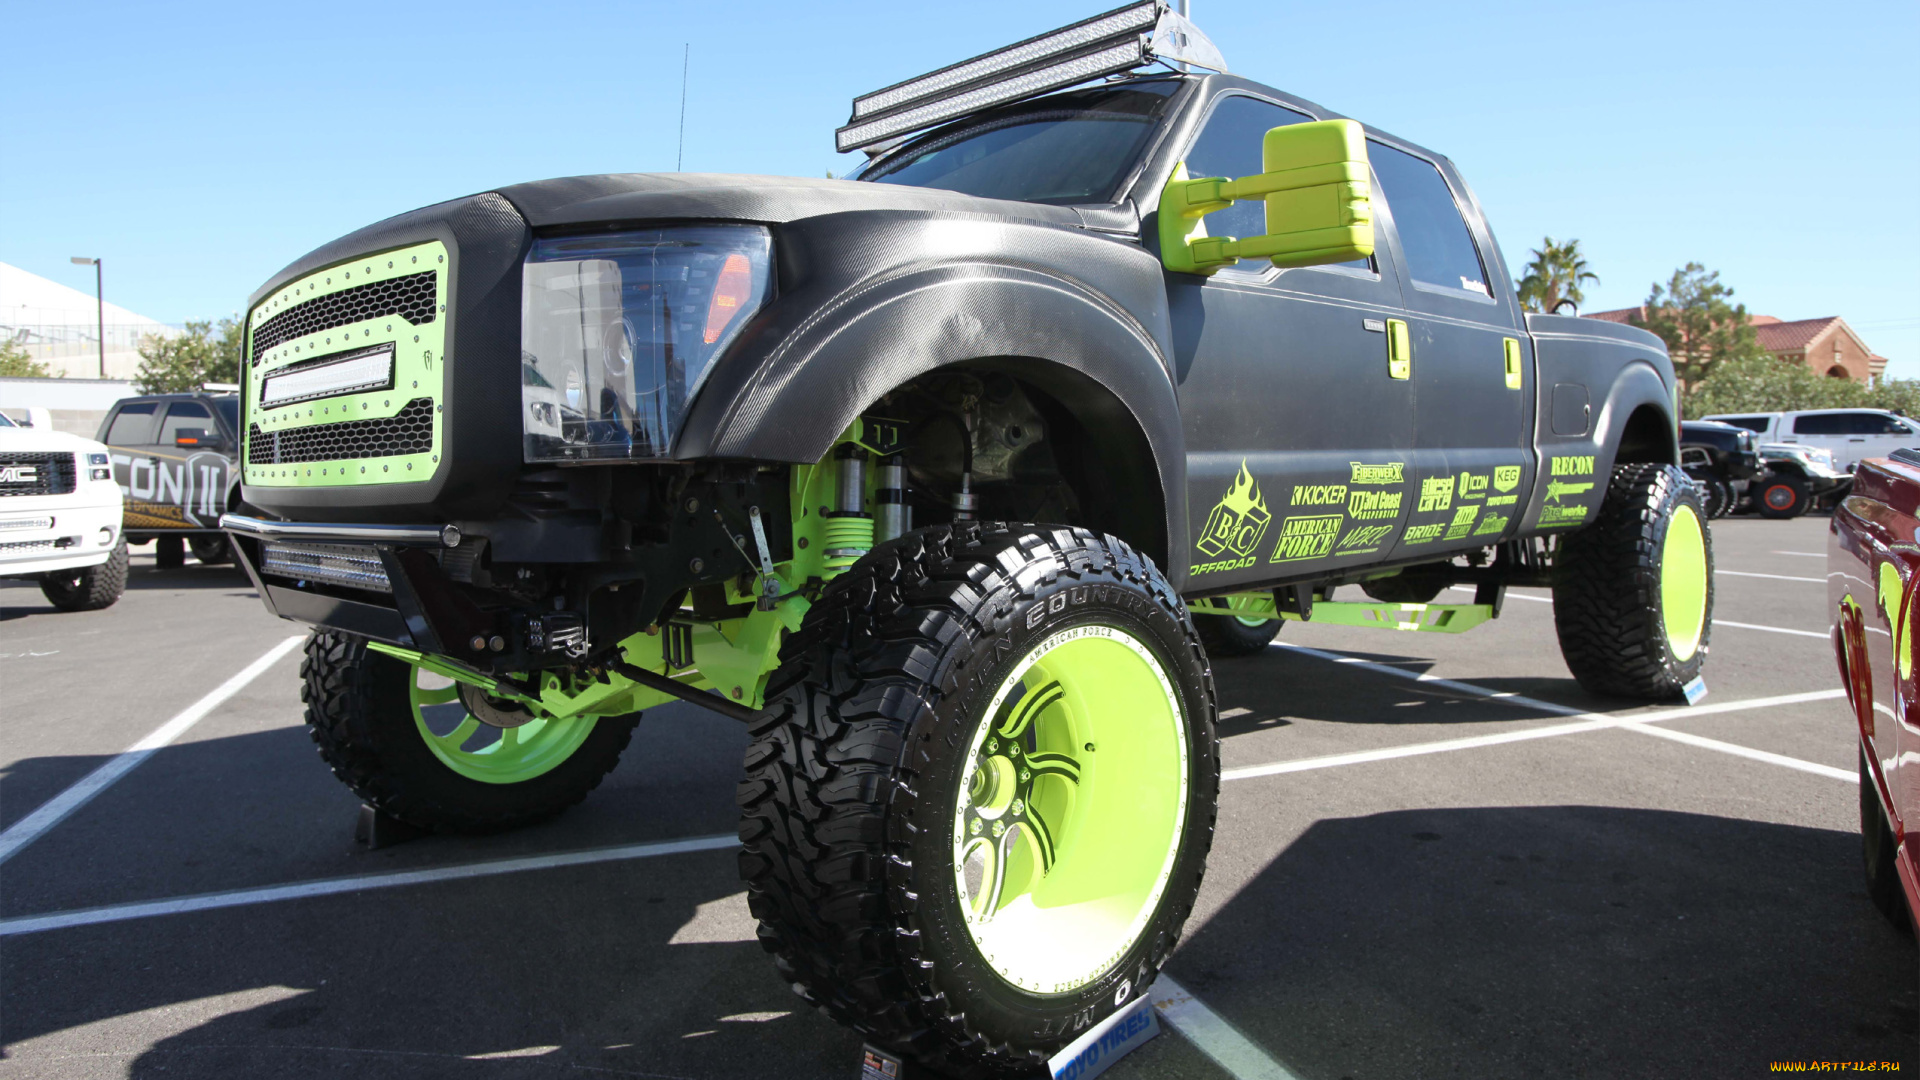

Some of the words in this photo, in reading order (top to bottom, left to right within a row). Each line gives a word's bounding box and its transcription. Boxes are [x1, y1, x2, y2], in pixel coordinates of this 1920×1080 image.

[0, 466, 38, 482] MC
[1497, 469, 1518, 482] KEG
[1551, 455, 1595, 476] RECON
[112, 454, 184, 506] CON
[1469, 475, 1489, 490] ICON
[1302, 485, 1347, 505] KICKER
[1363, 491, 1380, 510] 3rd
[1379, 491, 1402, 510] Coast
[1358, 509, 1399, 520] SUSPENSION
[1283, 519, 1341, 538] AMERICAN
[1404, 523, 1446, 540] BRIDE
[1274, 533, 1336, 559] FORCE
[1190, 556, 1256, 576] OFFROAD
[1026, 583, 1158, 630] COUNTRY
[1029, 629, 1079, 664] AMERICAN
[1082, 626, 1113, 638] FORCE
[1054, 1041, 1100, 1080] TOYO
[1099, 1007, 1151, 1056] TIRES
